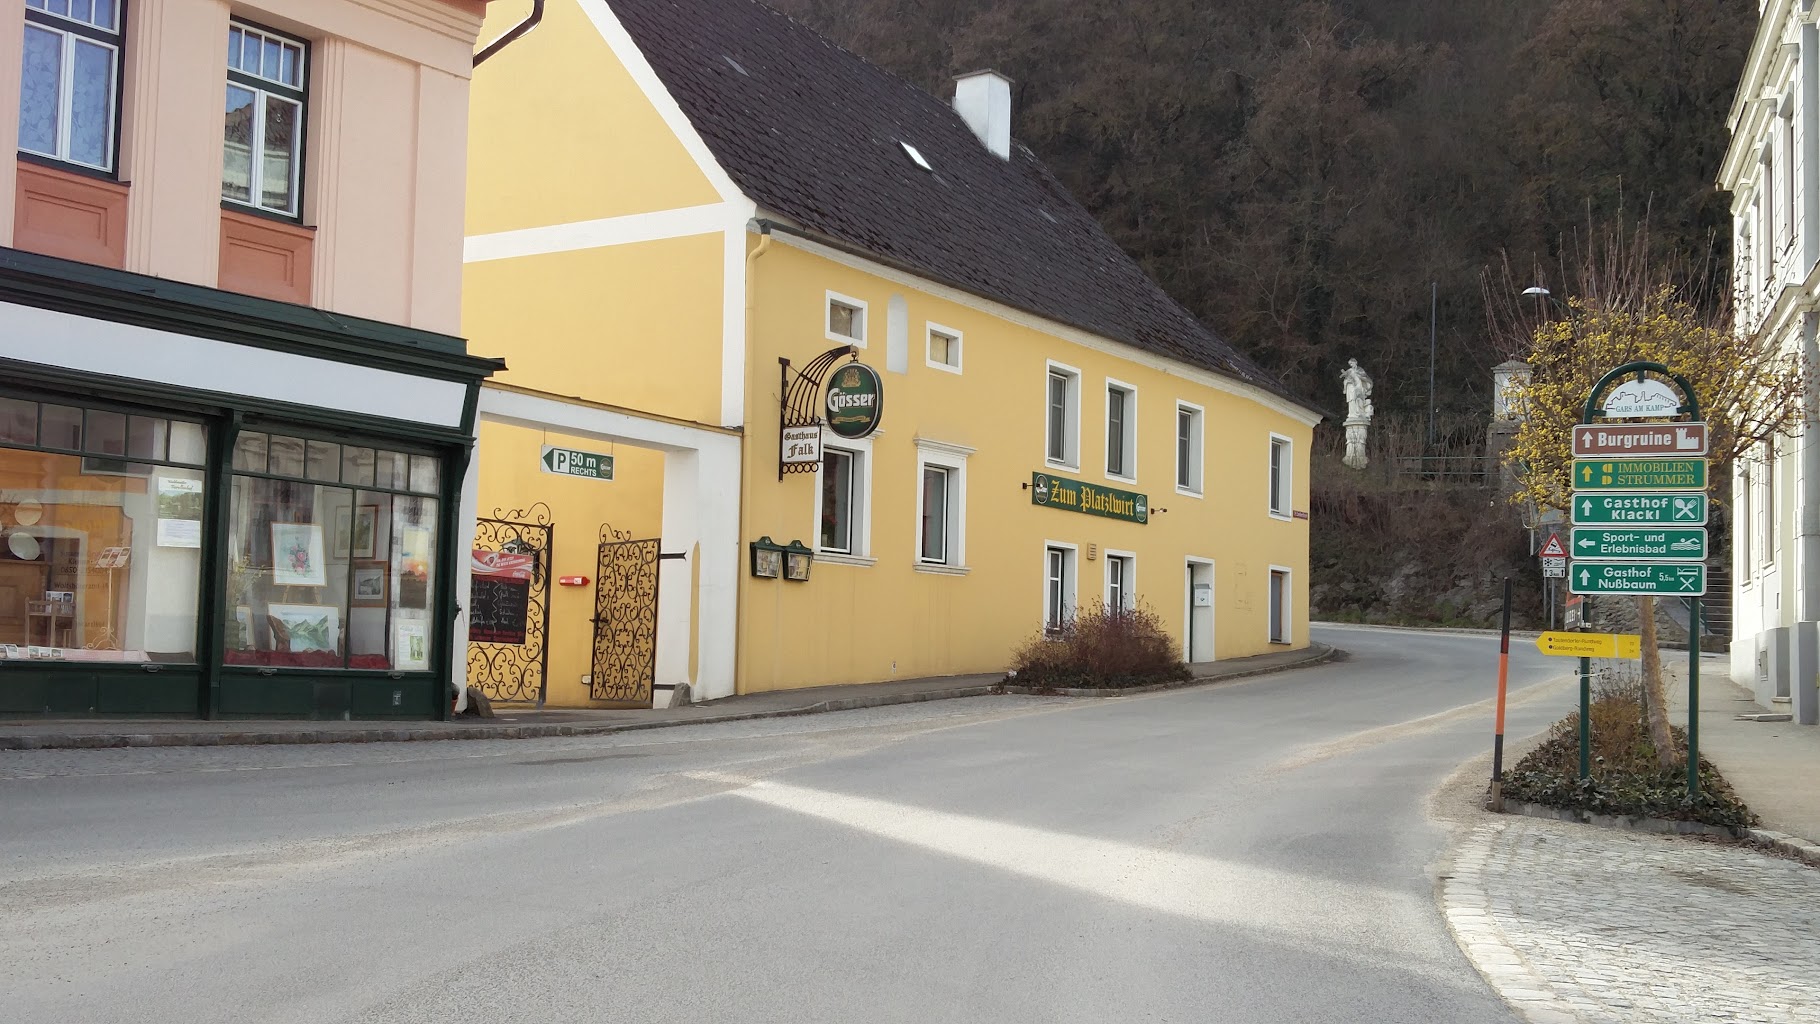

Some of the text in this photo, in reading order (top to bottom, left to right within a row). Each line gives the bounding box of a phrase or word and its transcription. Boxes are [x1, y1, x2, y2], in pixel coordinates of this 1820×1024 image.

[827, 387, 876, 413] Gösser
[784, 431, 818, 441] Gasthaus
[1597, 431, 1672, 449] Burgruine
[786, 443, 814, 459] Falk
[557, 452, 596, 470] P 50 m
[570, 466, 597, 477] RECHTS
[1617, 462, 1695, 473] IMMOBILIEN
[1617, 474, 1695, 485] STRUMMER
[1050, 479, 1135, 517] Zum Platzlwirt
[1603, 497, 1669, 509] Gasthof
[1611, 509, 1660, 520] Klackl
[1602, 532, 1665, 543] Sport- und
[1600, 544, 1667, 554] Erlebnisbad
[1603, 567, 1652, 578] Gasthof
[1598, 579, 1657, 590] Nußbaum
